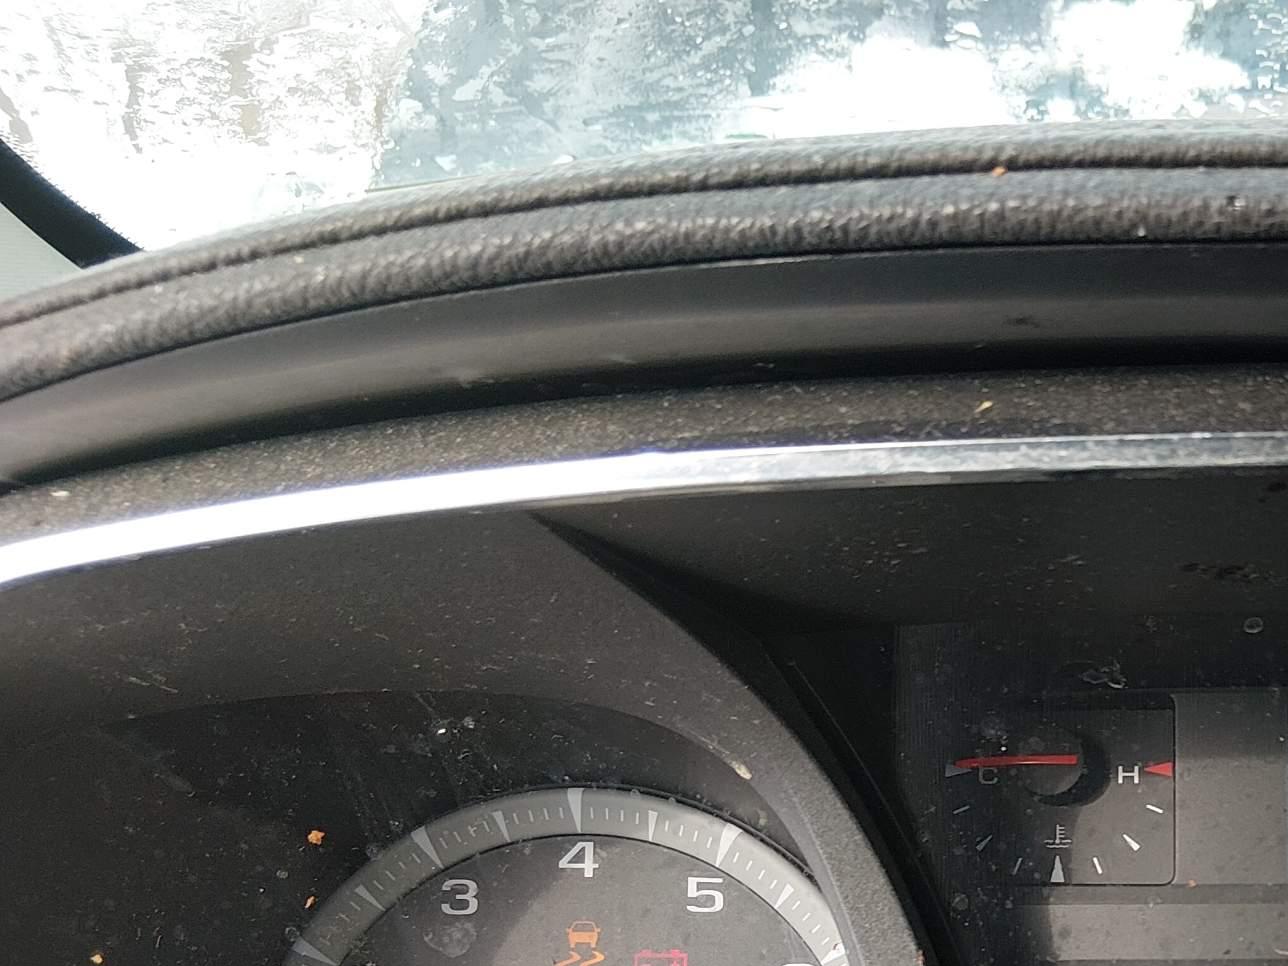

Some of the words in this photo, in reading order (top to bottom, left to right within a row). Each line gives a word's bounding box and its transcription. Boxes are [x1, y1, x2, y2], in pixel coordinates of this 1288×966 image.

[1117, 765, 1140, 785] H
[558, 842, 599, 878] 4
[440, 879, 478, 915] 3
[686, 877, 724, 914] 5
